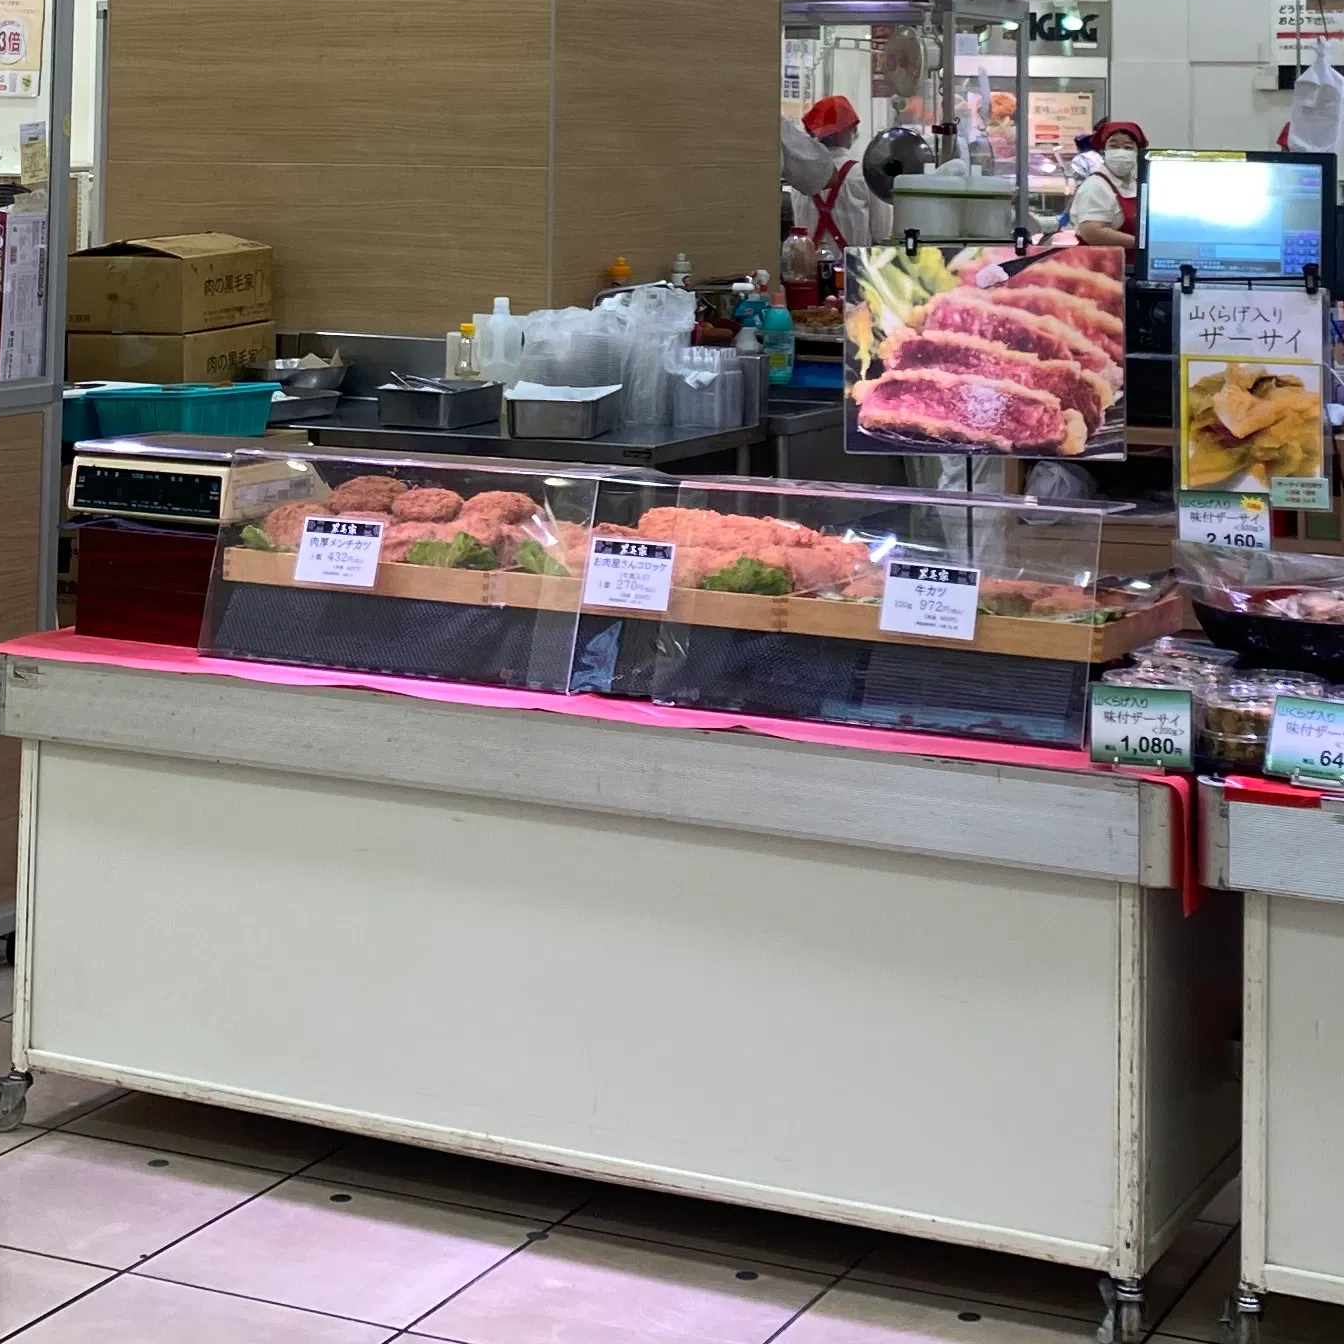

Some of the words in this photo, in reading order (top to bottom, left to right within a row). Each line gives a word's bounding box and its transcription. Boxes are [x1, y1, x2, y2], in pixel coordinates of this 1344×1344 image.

[204, 271, 255, 296] 肉の黒毛家
[1188, 305, 1283, 324] 山くらげ入り
[1199, 326, 1303, 354] ザーサイ
[1104, 710, 1180, 727] 味付ザーサイ
